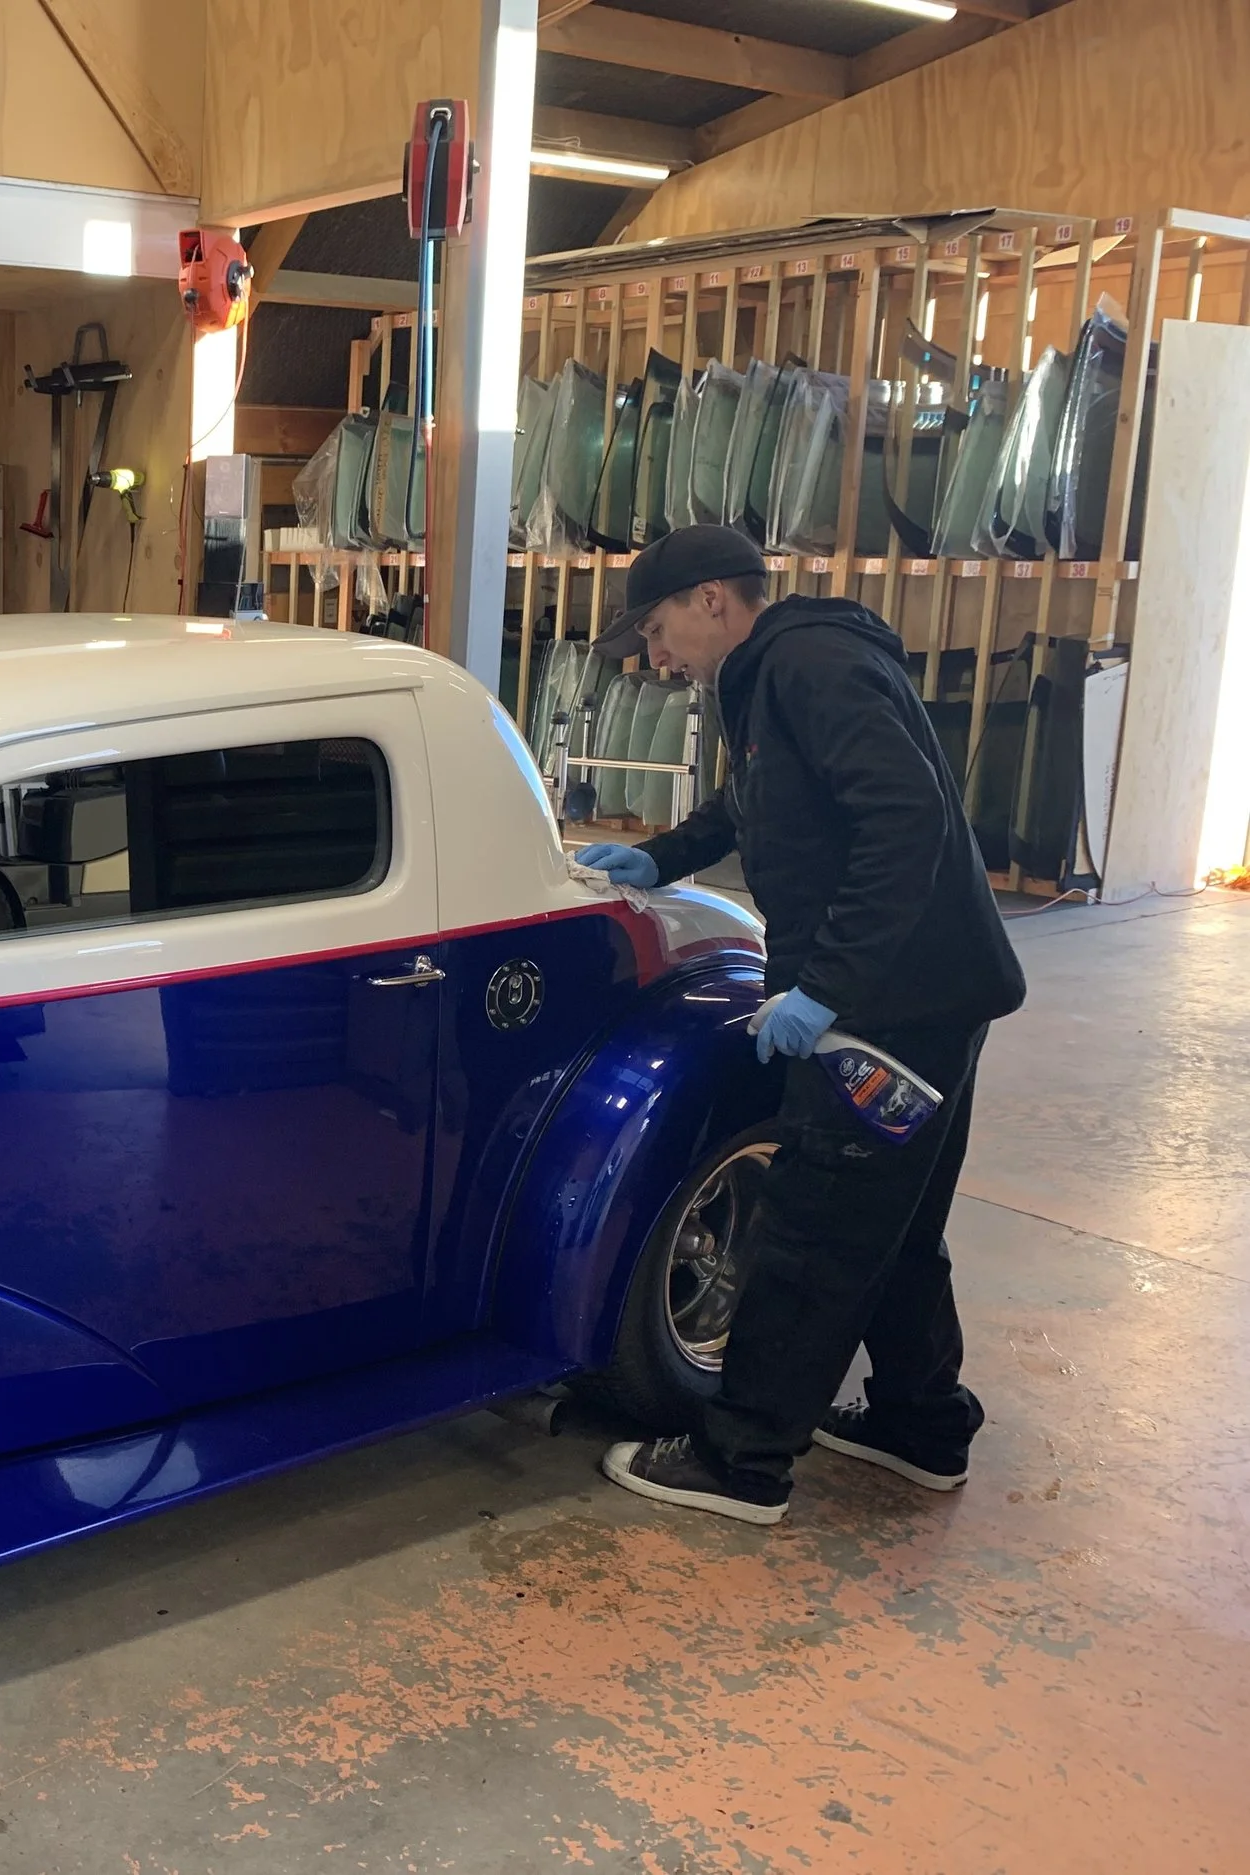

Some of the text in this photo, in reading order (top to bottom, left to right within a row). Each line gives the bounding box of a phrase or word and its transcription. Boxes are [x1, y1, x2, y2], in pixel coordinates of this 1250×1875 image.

[1117, 219, 1129, 231] 19
[1058, 226, 1070, 238] 18
[1001, 235, 1013, 247] 17
[898, 247, 909, 259] 15
[946, 242, 957, 254] 16
[797, 261, 807, 272] 13
[842, 255, 853, 267] 14
[710, 273, 719, 283] 11
[750, 267, 761, 278] 12
[638, 283, 645, 294] 9
[675, 278, 684, 288] 10
[564, 294, 571, 303] 7
[599, 288, 606, 298] 8
[529, 299, 536, 308] 6
[1016, 563, 1030, 576] 37
[1072, 564, 1086, 577] 38
[845, 1061, 871, 1091] ICE
